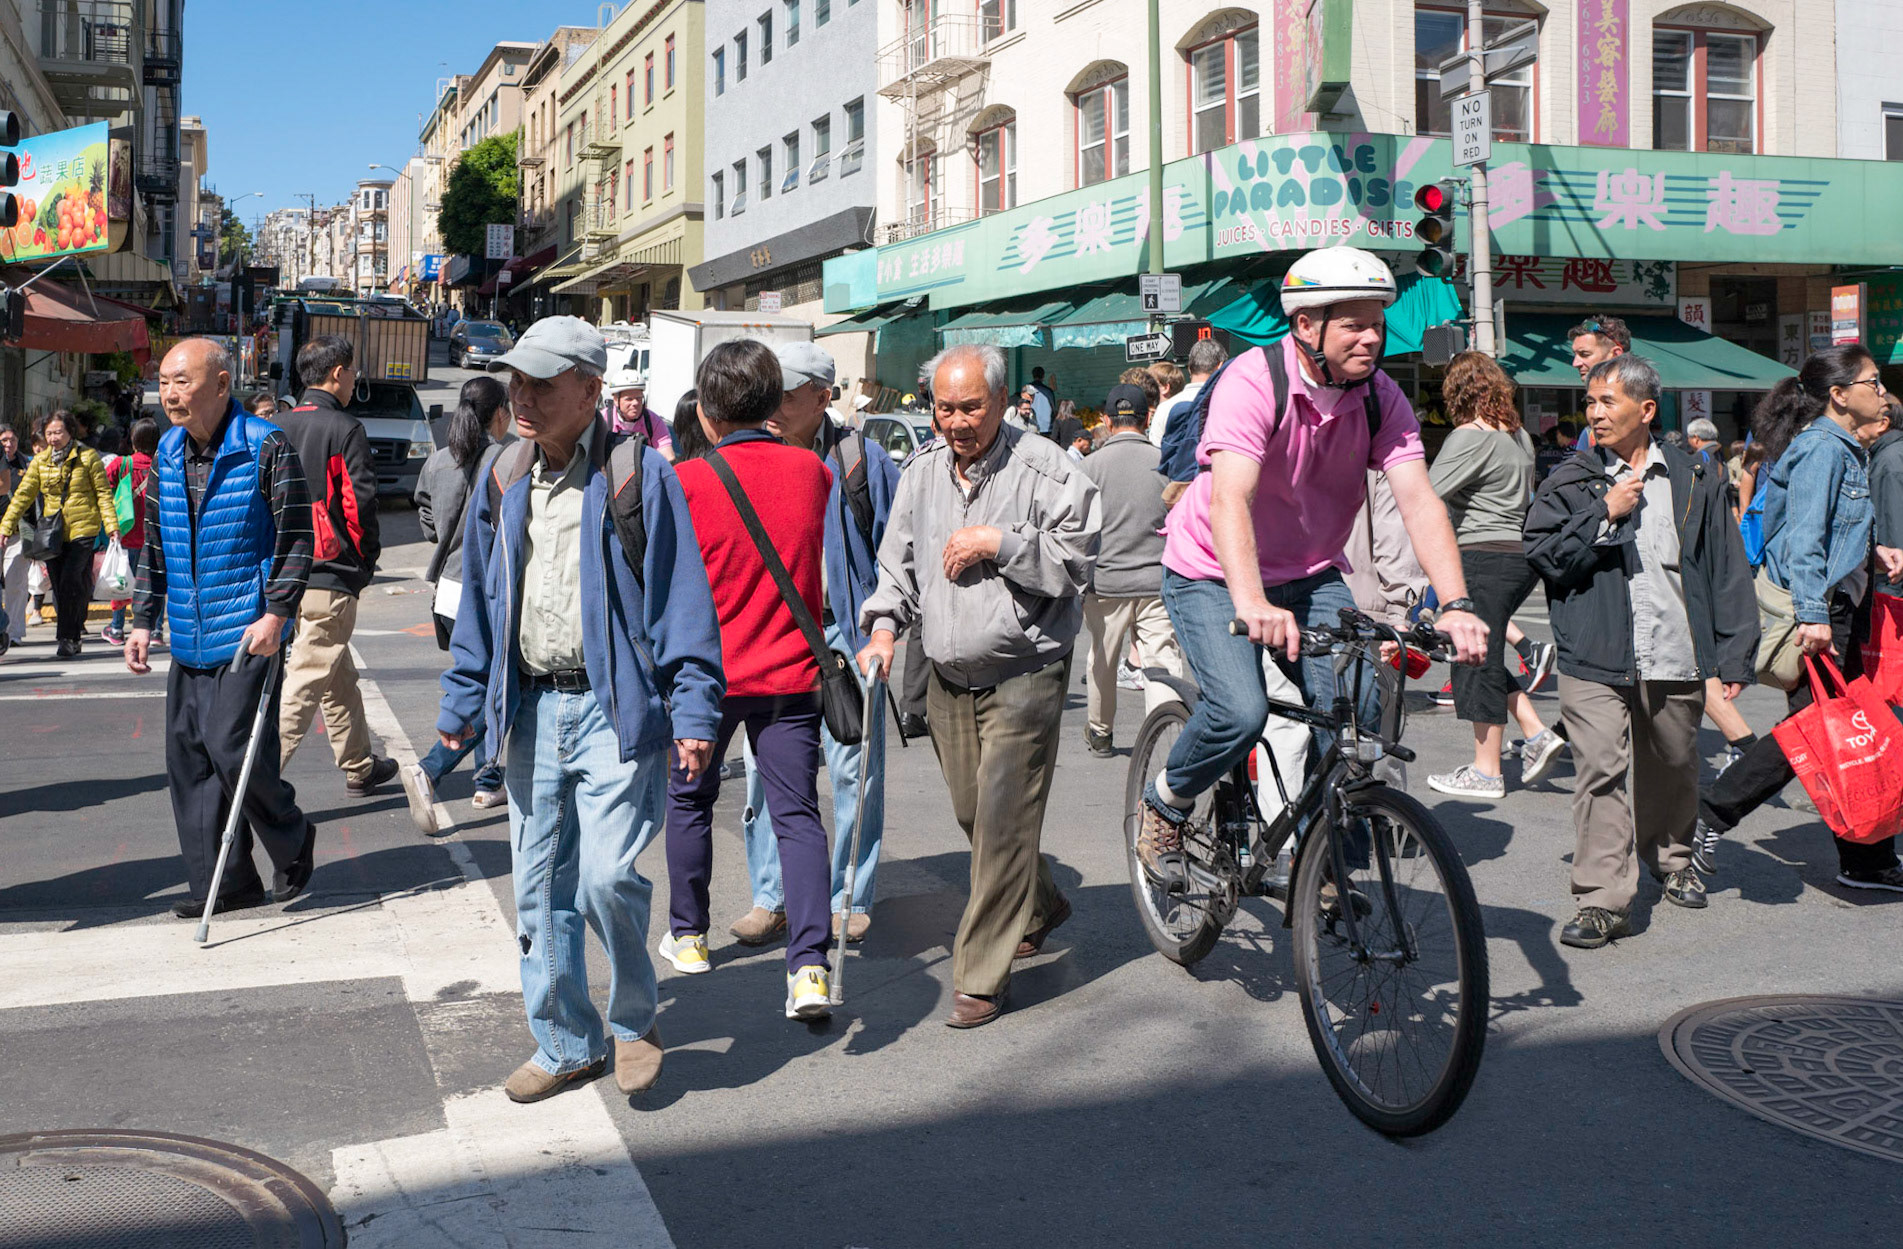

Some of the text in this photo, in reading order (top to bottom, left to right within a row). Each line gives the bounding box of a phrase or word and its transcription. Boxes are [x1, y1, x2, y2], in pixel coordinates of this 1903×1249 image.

[1463, 100, 1480, 116] NO
[1460, 116, 1482, 131] TURN
[1465, 132, 1478, 144] ON
[1463, 146, 1480, 159] RED
[1238, 144, 1377, 181] LITTLE
[1214, 177, 1414, 219] PARADISE
[1217, 219, 1413, 247] JUICES CANDIES GIFTS
[1130, 341, 1159, 353] ONE WAY
[1784, 323, 1800, 364] 東方
